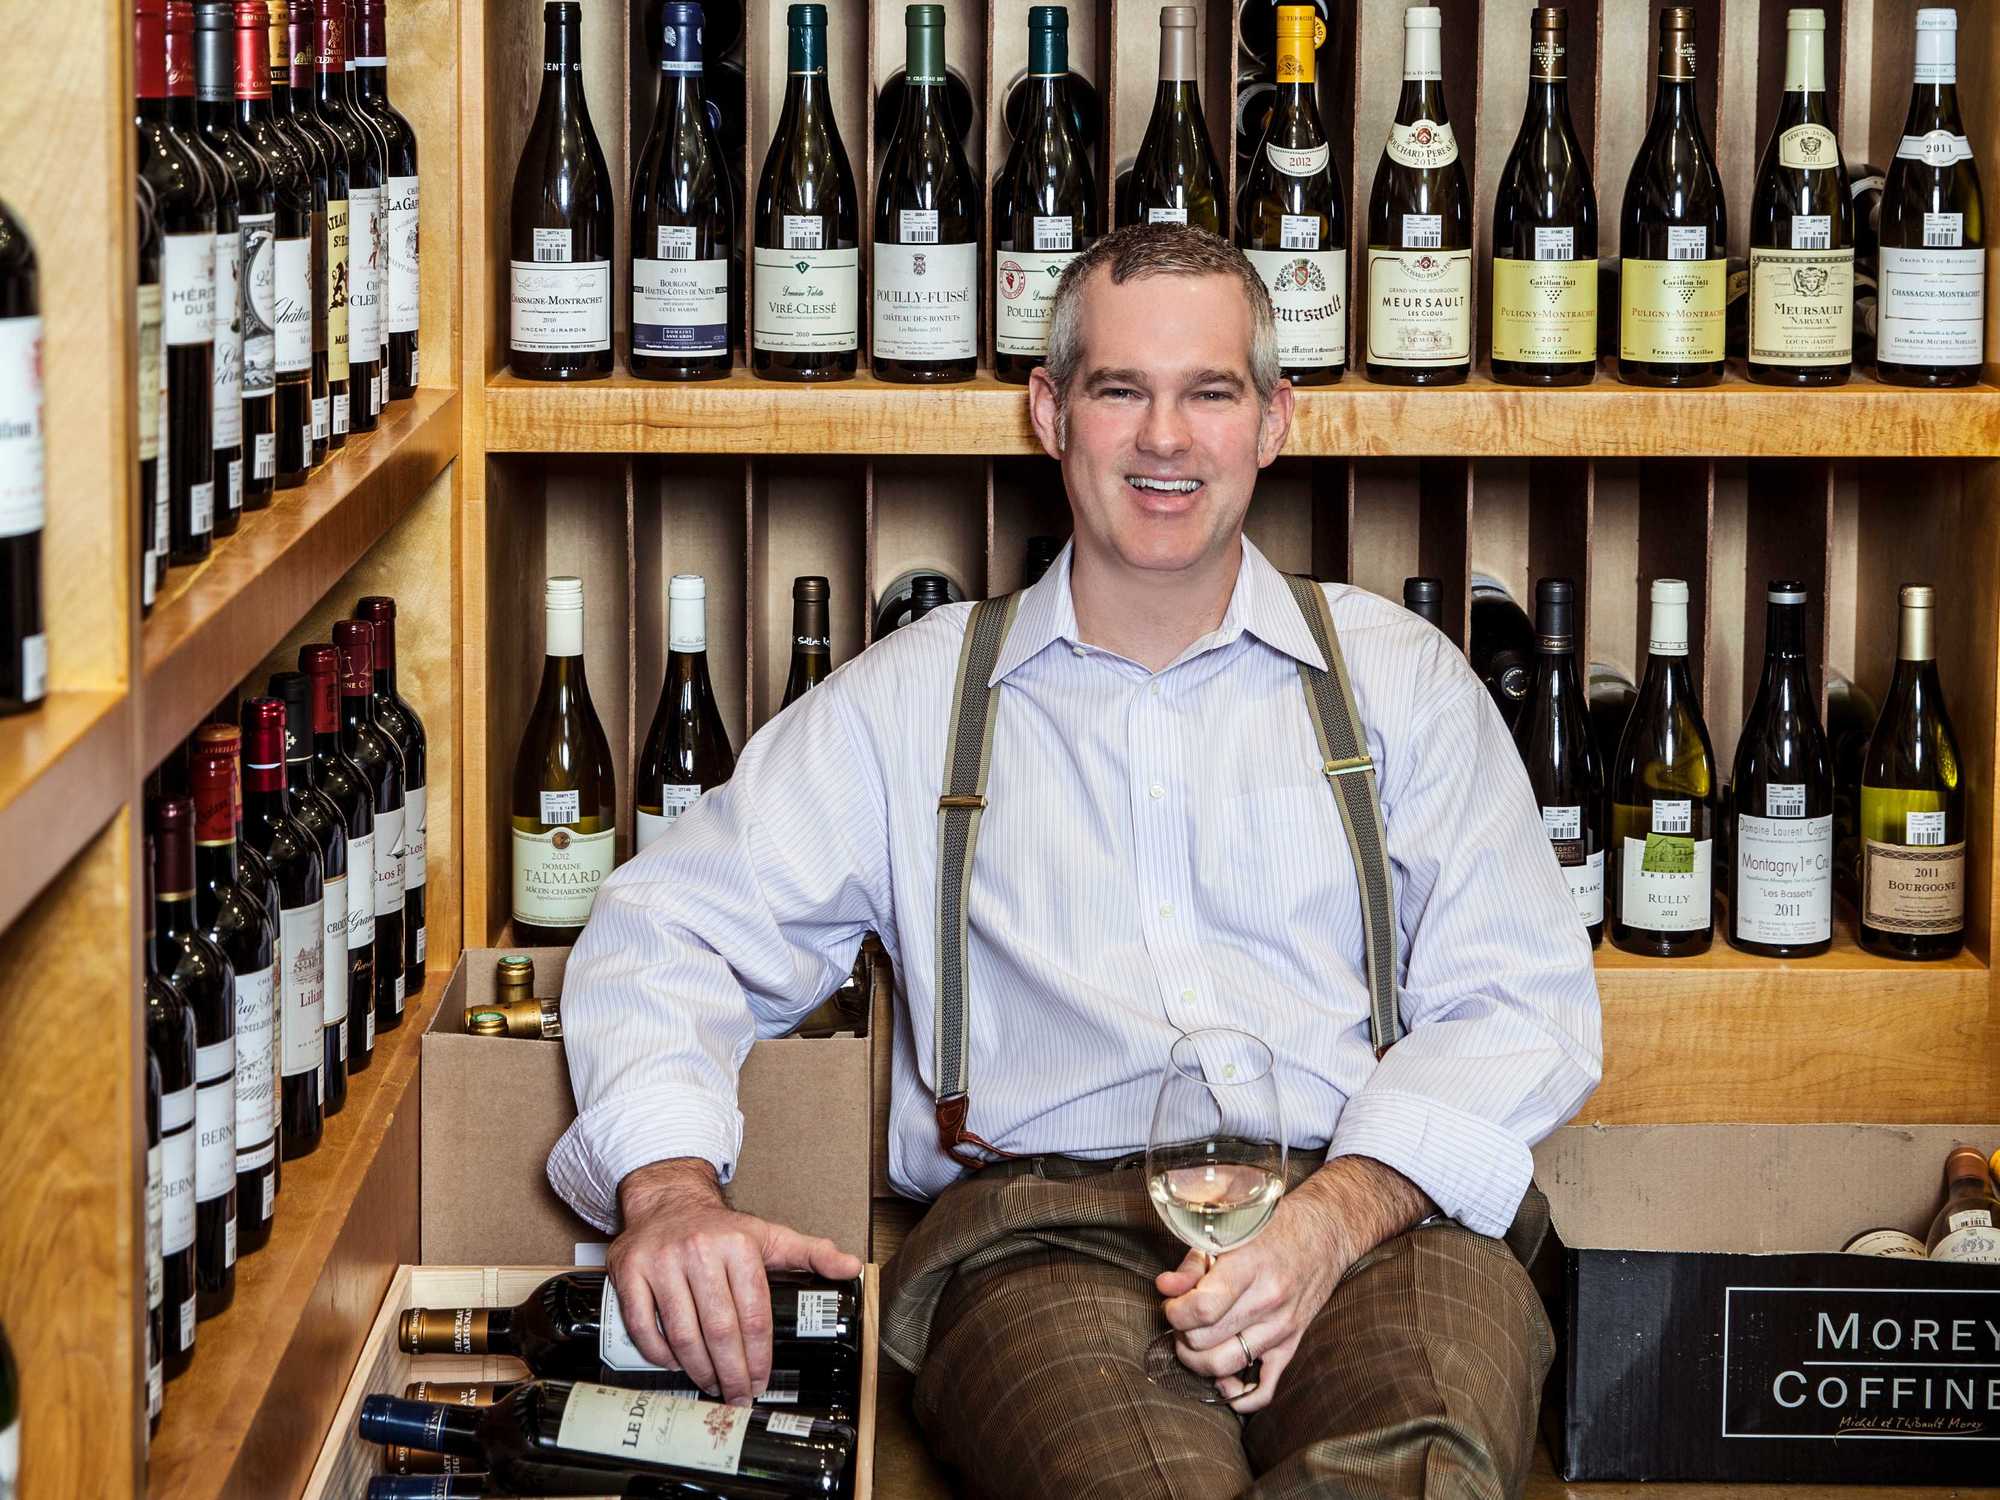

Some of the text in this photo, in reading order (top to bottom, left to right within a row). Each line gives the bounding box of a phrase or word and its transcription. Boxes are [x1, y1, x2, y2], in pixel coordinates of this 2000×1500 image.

[1925, 143, 1953, 153] 2011
[1288, 157, 1312, 167] 2012
[876, 287, 969, 304] POUILLY-FUISSÉ
[1382, 296, 1464, 308] MEURSAULT
[769, 302, 837, 314] VIRÉ-CLESSÉ
[1274, 293, 1342, 322] eursault
[1774, 302, 1843, 315] MEURSAULT
[1742, 852, 1799, 877] Montagny
[523, 869, 601, 885] TALMARD
[1914, 867, 1939, 878] 2011
[1888, 880, 1956, 892] BOURGOGNE
[1648, 893, 1690, 904] RULLY
[1775, 903, 1801, 917] 2011
[1817, 1312, 2000, 1351] MOREY
[1839, 1414, 1879, 1429] Michel
[1880, 1416, 1894, 1428] et
[622, 1422, 643, 1449] LE
